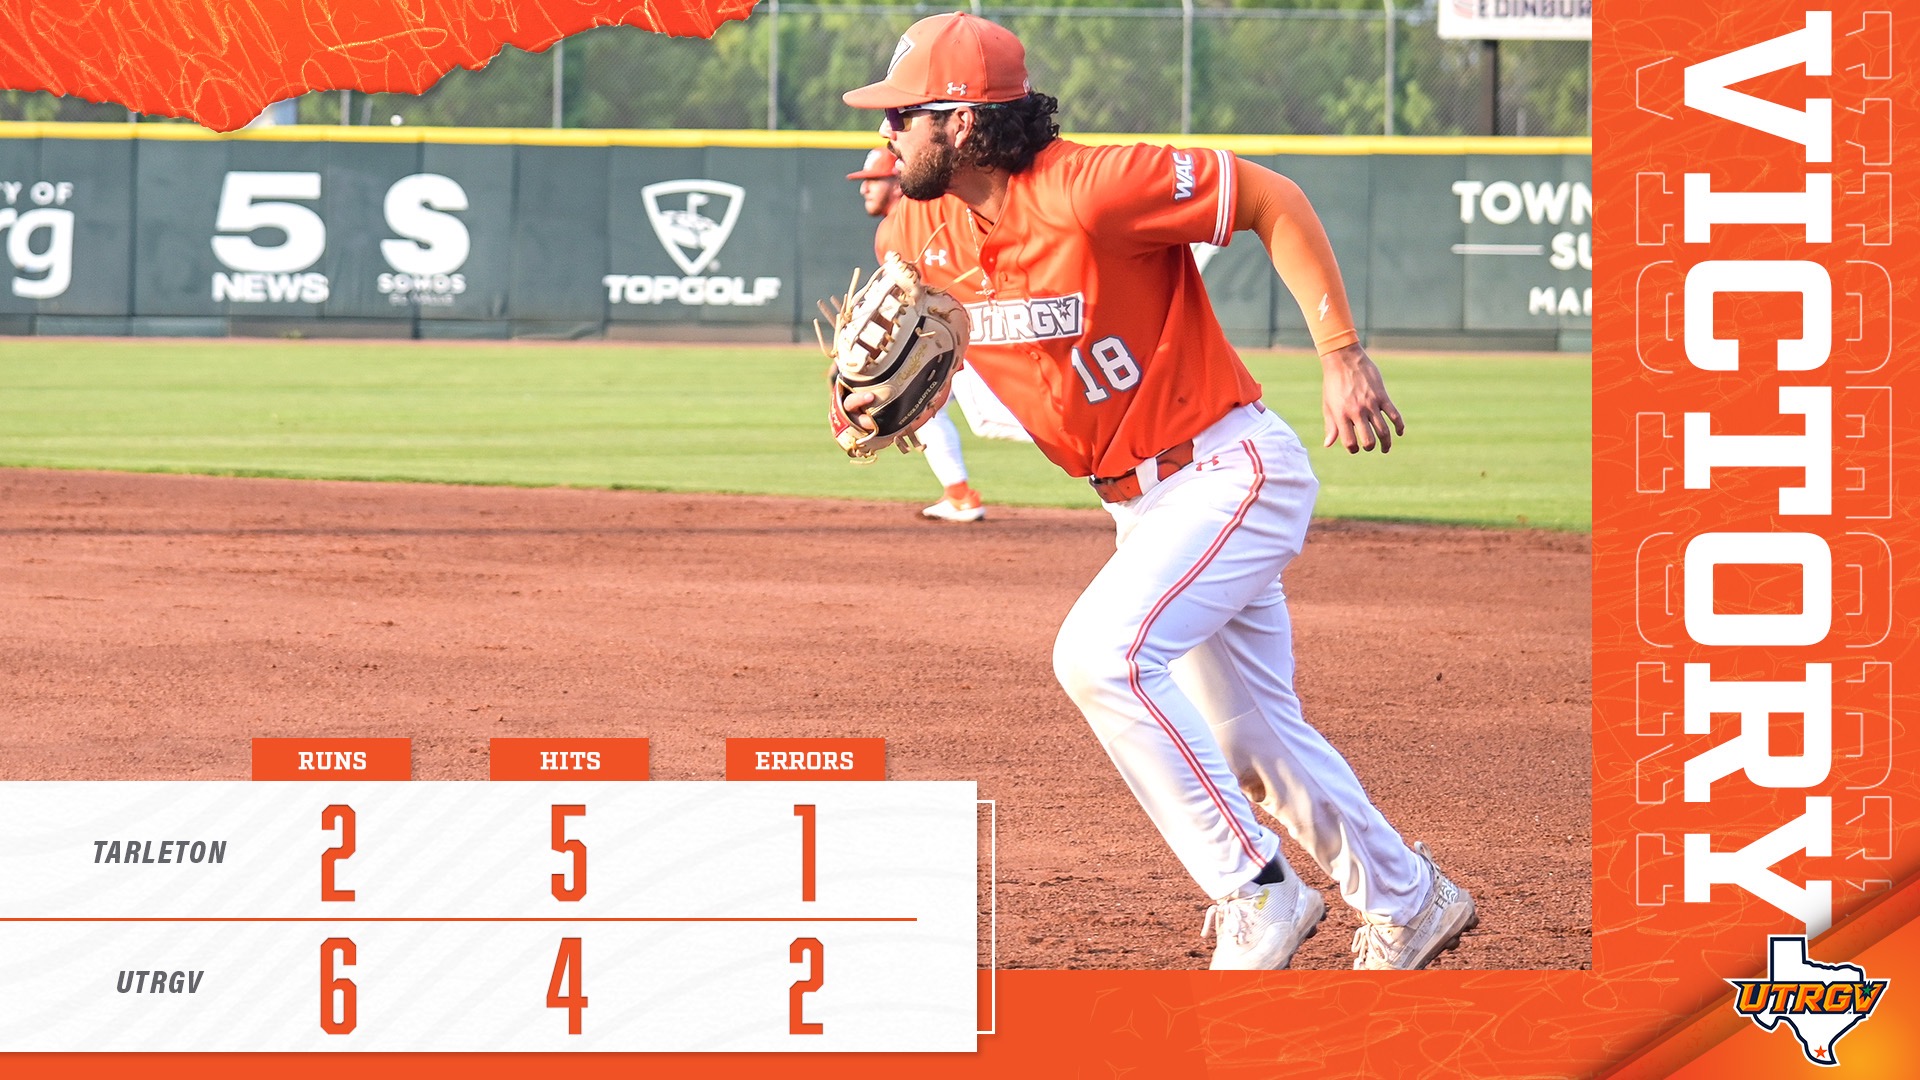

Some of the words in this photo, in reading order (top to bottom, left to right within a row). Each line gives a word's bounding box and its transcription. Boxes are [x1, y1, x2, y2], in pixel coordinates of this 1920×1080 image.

[0, 181, 22, 204] Y
[30, 181, 73, 205] OF
[1172, 152, 1194, 200] WAC
[211, 171, 326, 273] 5
[379, 173, 470, 276] S
[211, 272, 330, 303] NEWS
[602, 274, 781, 306] TOPGOLF
[1071, 335, 1142, 404] 18
